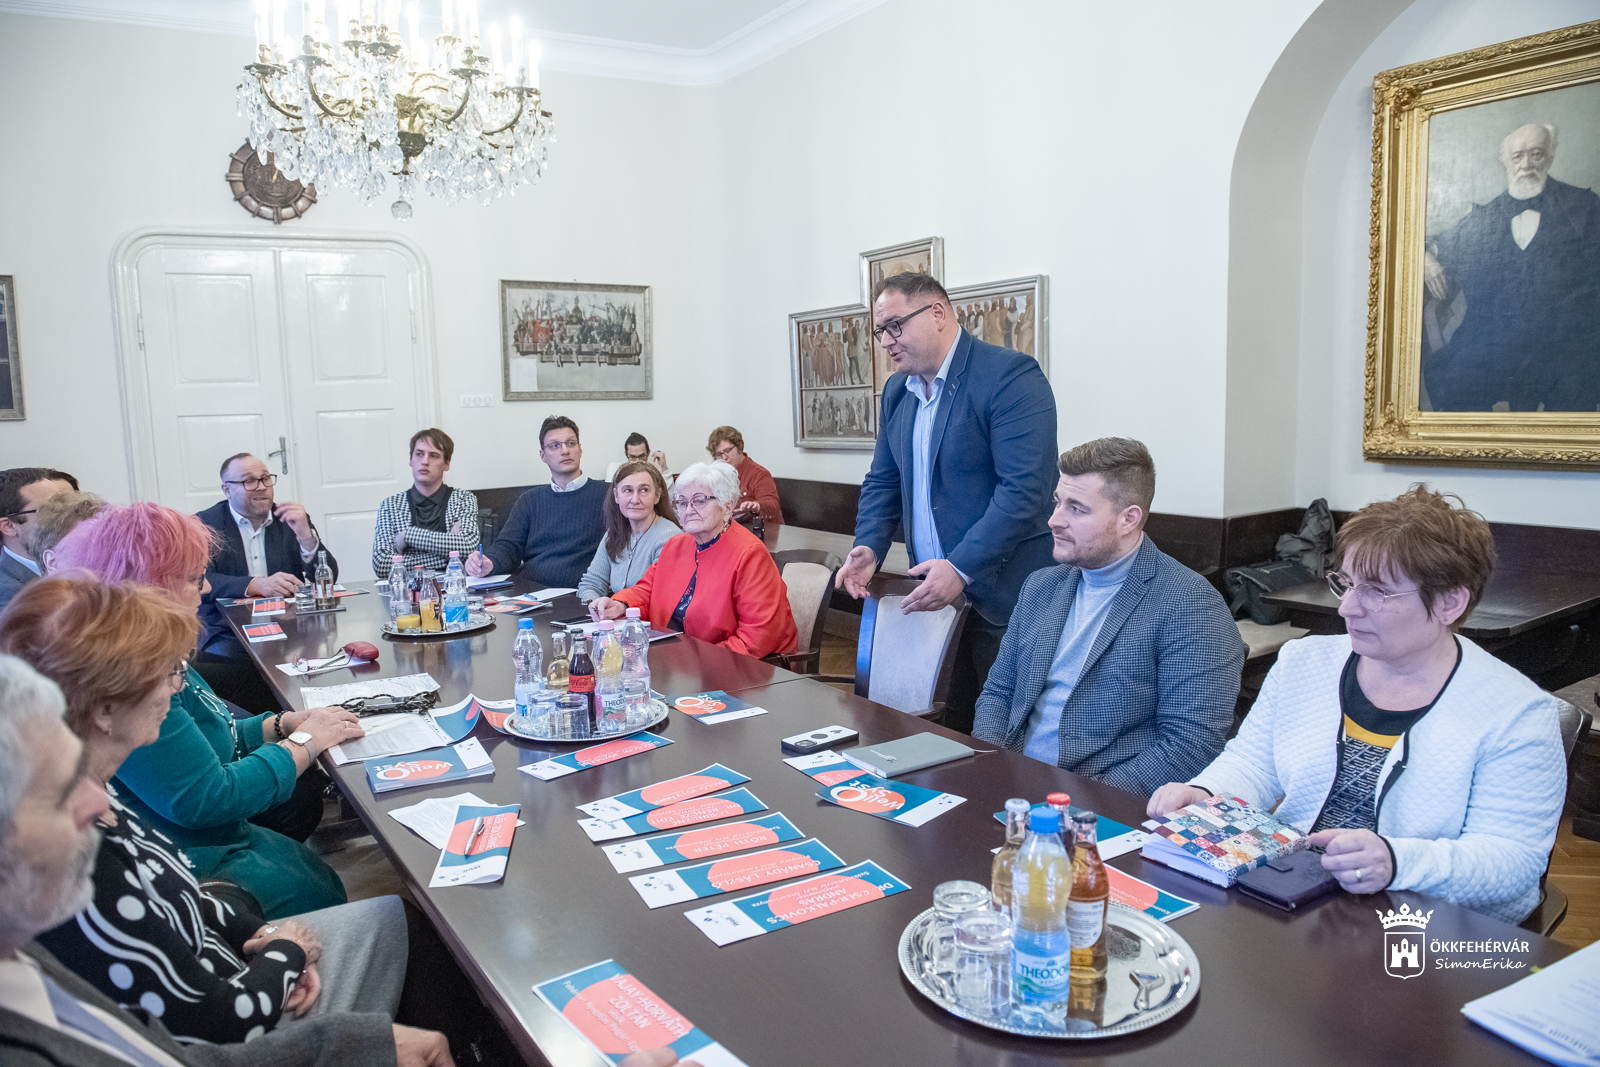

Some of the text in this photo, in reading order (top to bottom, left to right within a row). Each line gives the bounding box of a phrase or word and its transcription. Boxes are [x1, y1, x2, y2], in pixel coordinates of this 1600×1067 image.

[372, 760, 420, 773] Syst
[849, 780, 892, 800] Syst
[693, 835, 767, 854] RÓTH PÉTER
[710, 860, 822, 889] CSANÁDY LÁSZLÓ
[767, 882, 894, 923] DR. CSER-PALKOVICS
[798, 888, 846, 905] ANDRÁS
[608, 996, 652, 1029] ZOLTÁN
[609, 973, 690, 1037] VAJAY-HORVÁTH
